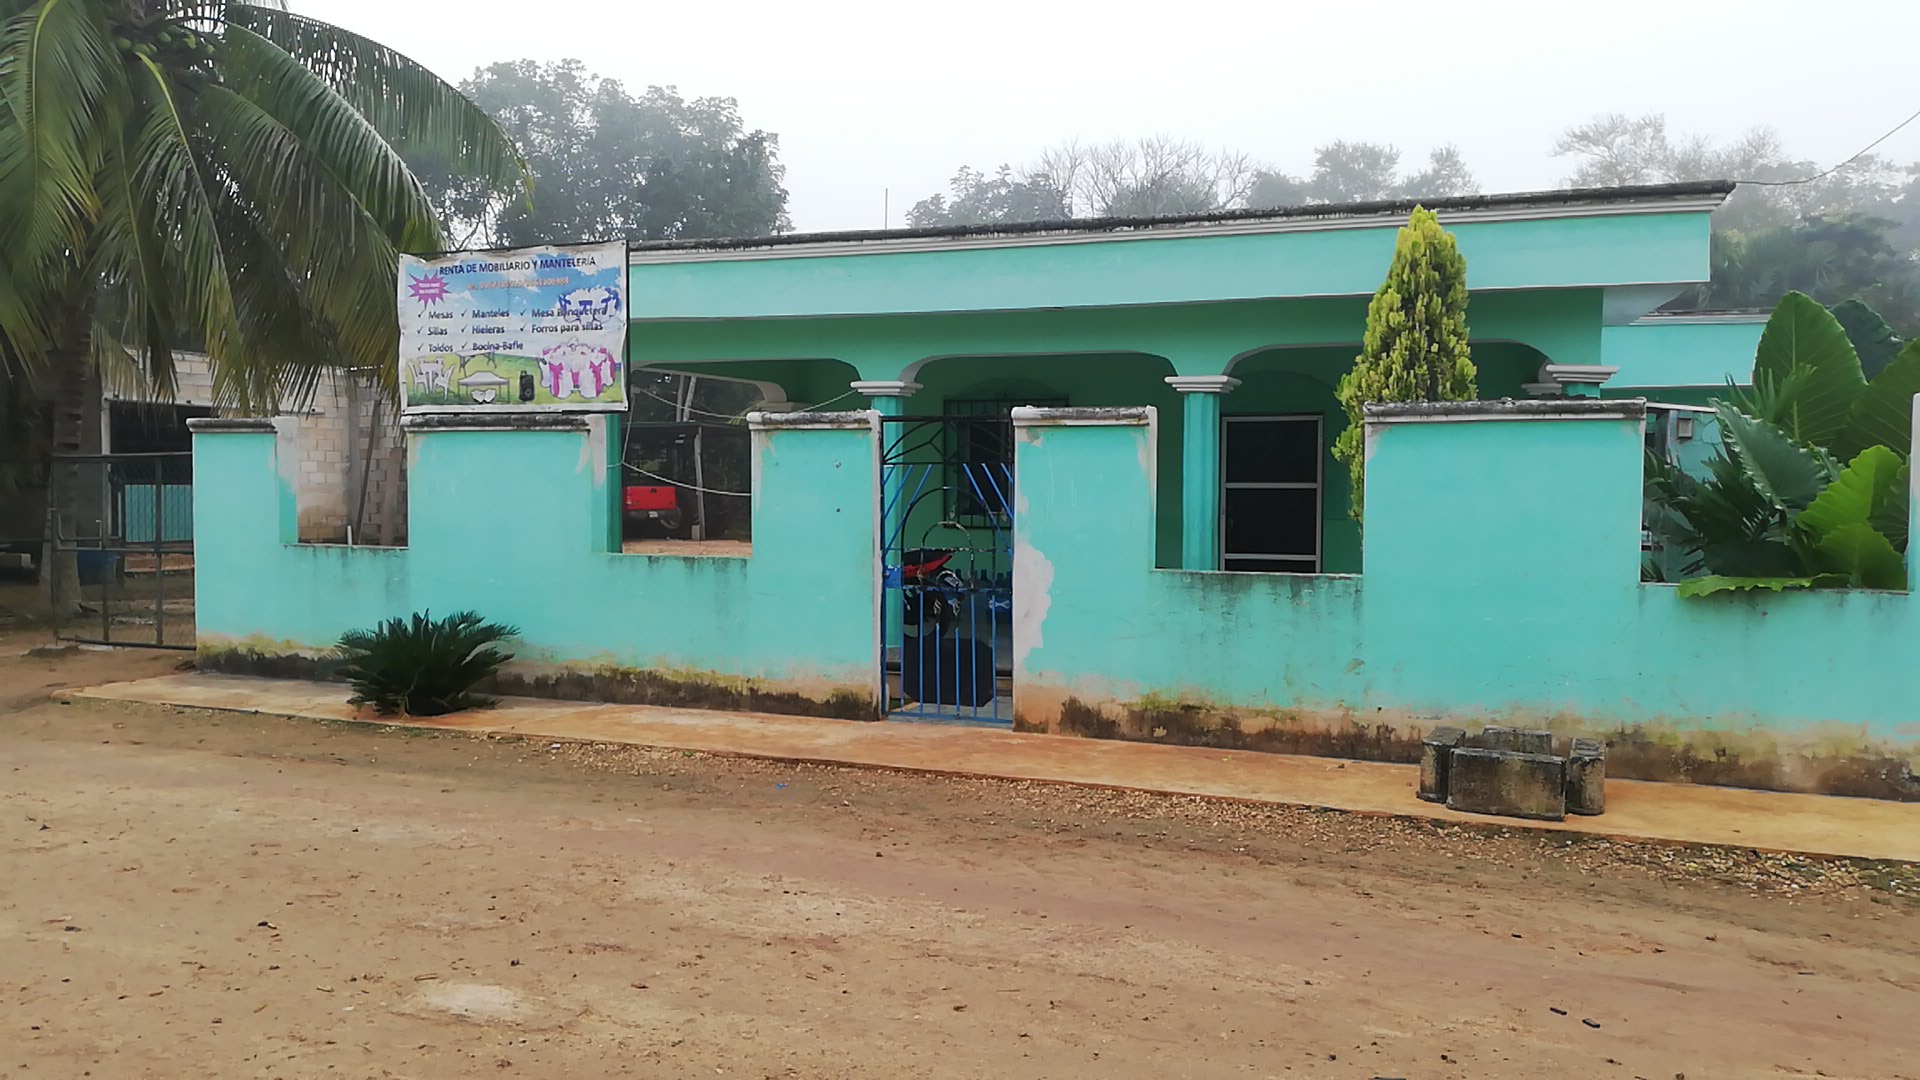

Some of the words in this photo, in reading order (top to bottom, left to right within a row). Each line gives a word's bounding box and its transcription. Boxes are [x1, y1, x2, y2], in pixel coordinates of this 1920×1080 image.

[439, 265, 465, 276] RENTA
[466, 264, 477, 274] DE
[479, 261, 530, 273] MOBILIARIO
[531, 260, 538, 270] Y
[428, 311, 454, 319] Mesas
[472, 308, 510, 319] Manteles
[531, 309, 554, 318] Mesa
[427, 326, 448, 336] Sillas
[472, 324, 505, 335] Hieleras
[531, 324, 558, 334] Forros
[560, 325, 580, 334] para
[581, 321, 604, 331] sillas
